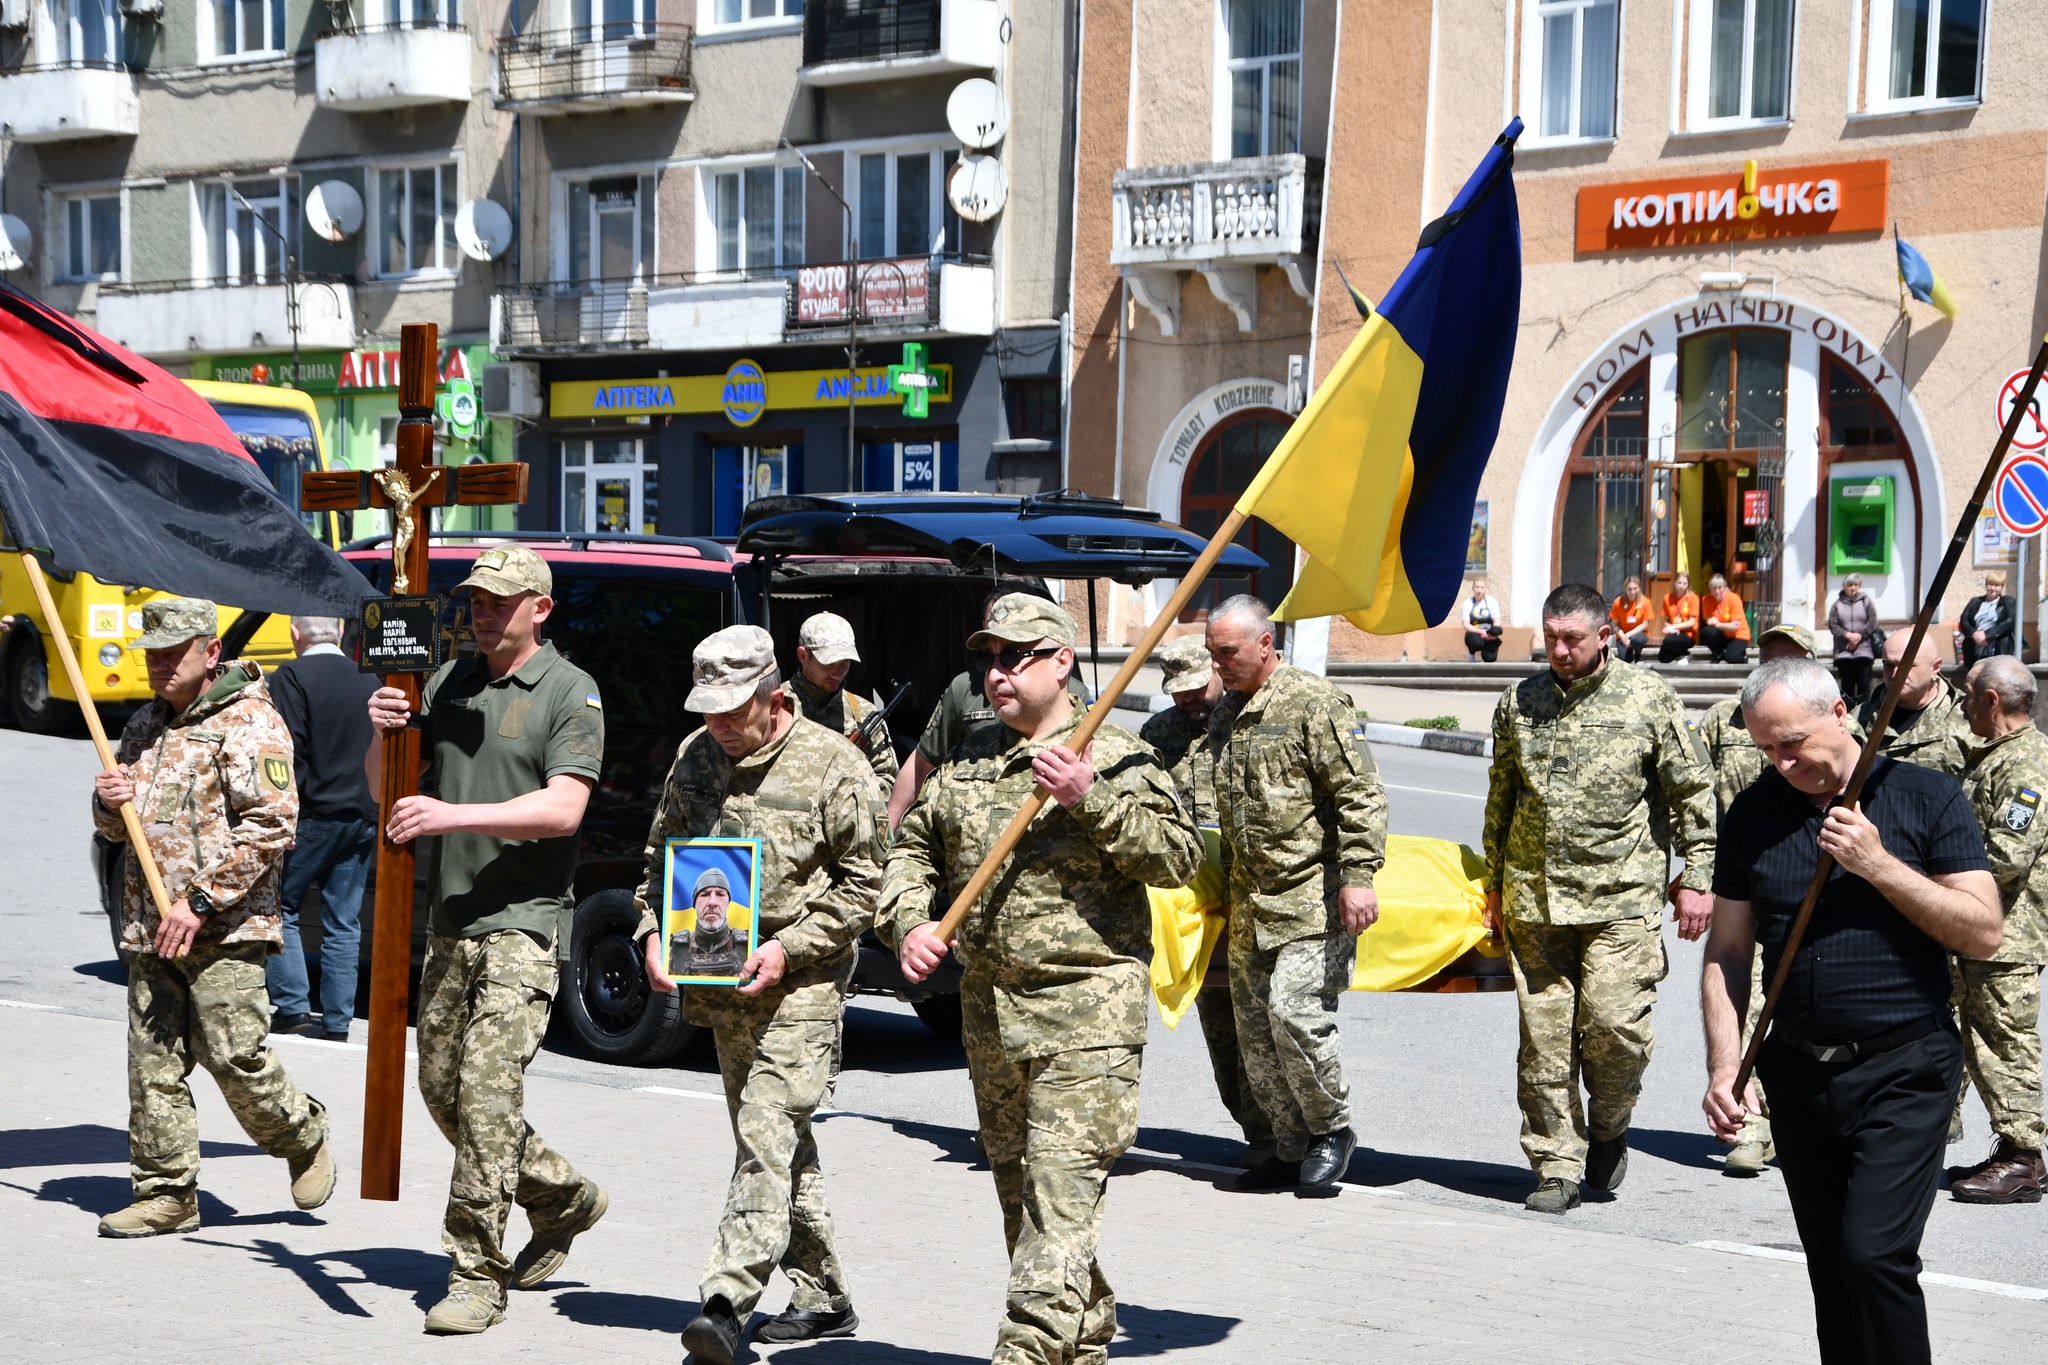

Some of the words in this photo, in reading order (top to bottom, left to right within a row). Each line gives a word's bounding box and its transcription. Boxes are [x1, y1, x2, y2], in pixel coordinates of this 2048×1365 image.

[1727, 221, 1767, 239] треба
[800, 265, 847, 294] ФОТО
[801, 293, 839, 319] студія
[1573, 328, 1655, 410] DOM
[1674, 299, 1894, 385] HANDLOWY
[279, 363, 336, 381] РОДИНА
[898, 372, 938, 388] АПТЕКА
[593, 384, 675, 409] АПТЕКА
[721, 382, 766, 405] АНЦ
[1169, 412, 1205, 466] TOWARY
[1213, 384, 1275, 415] KORZENNE
[904, 460, 933, 481] 5%
